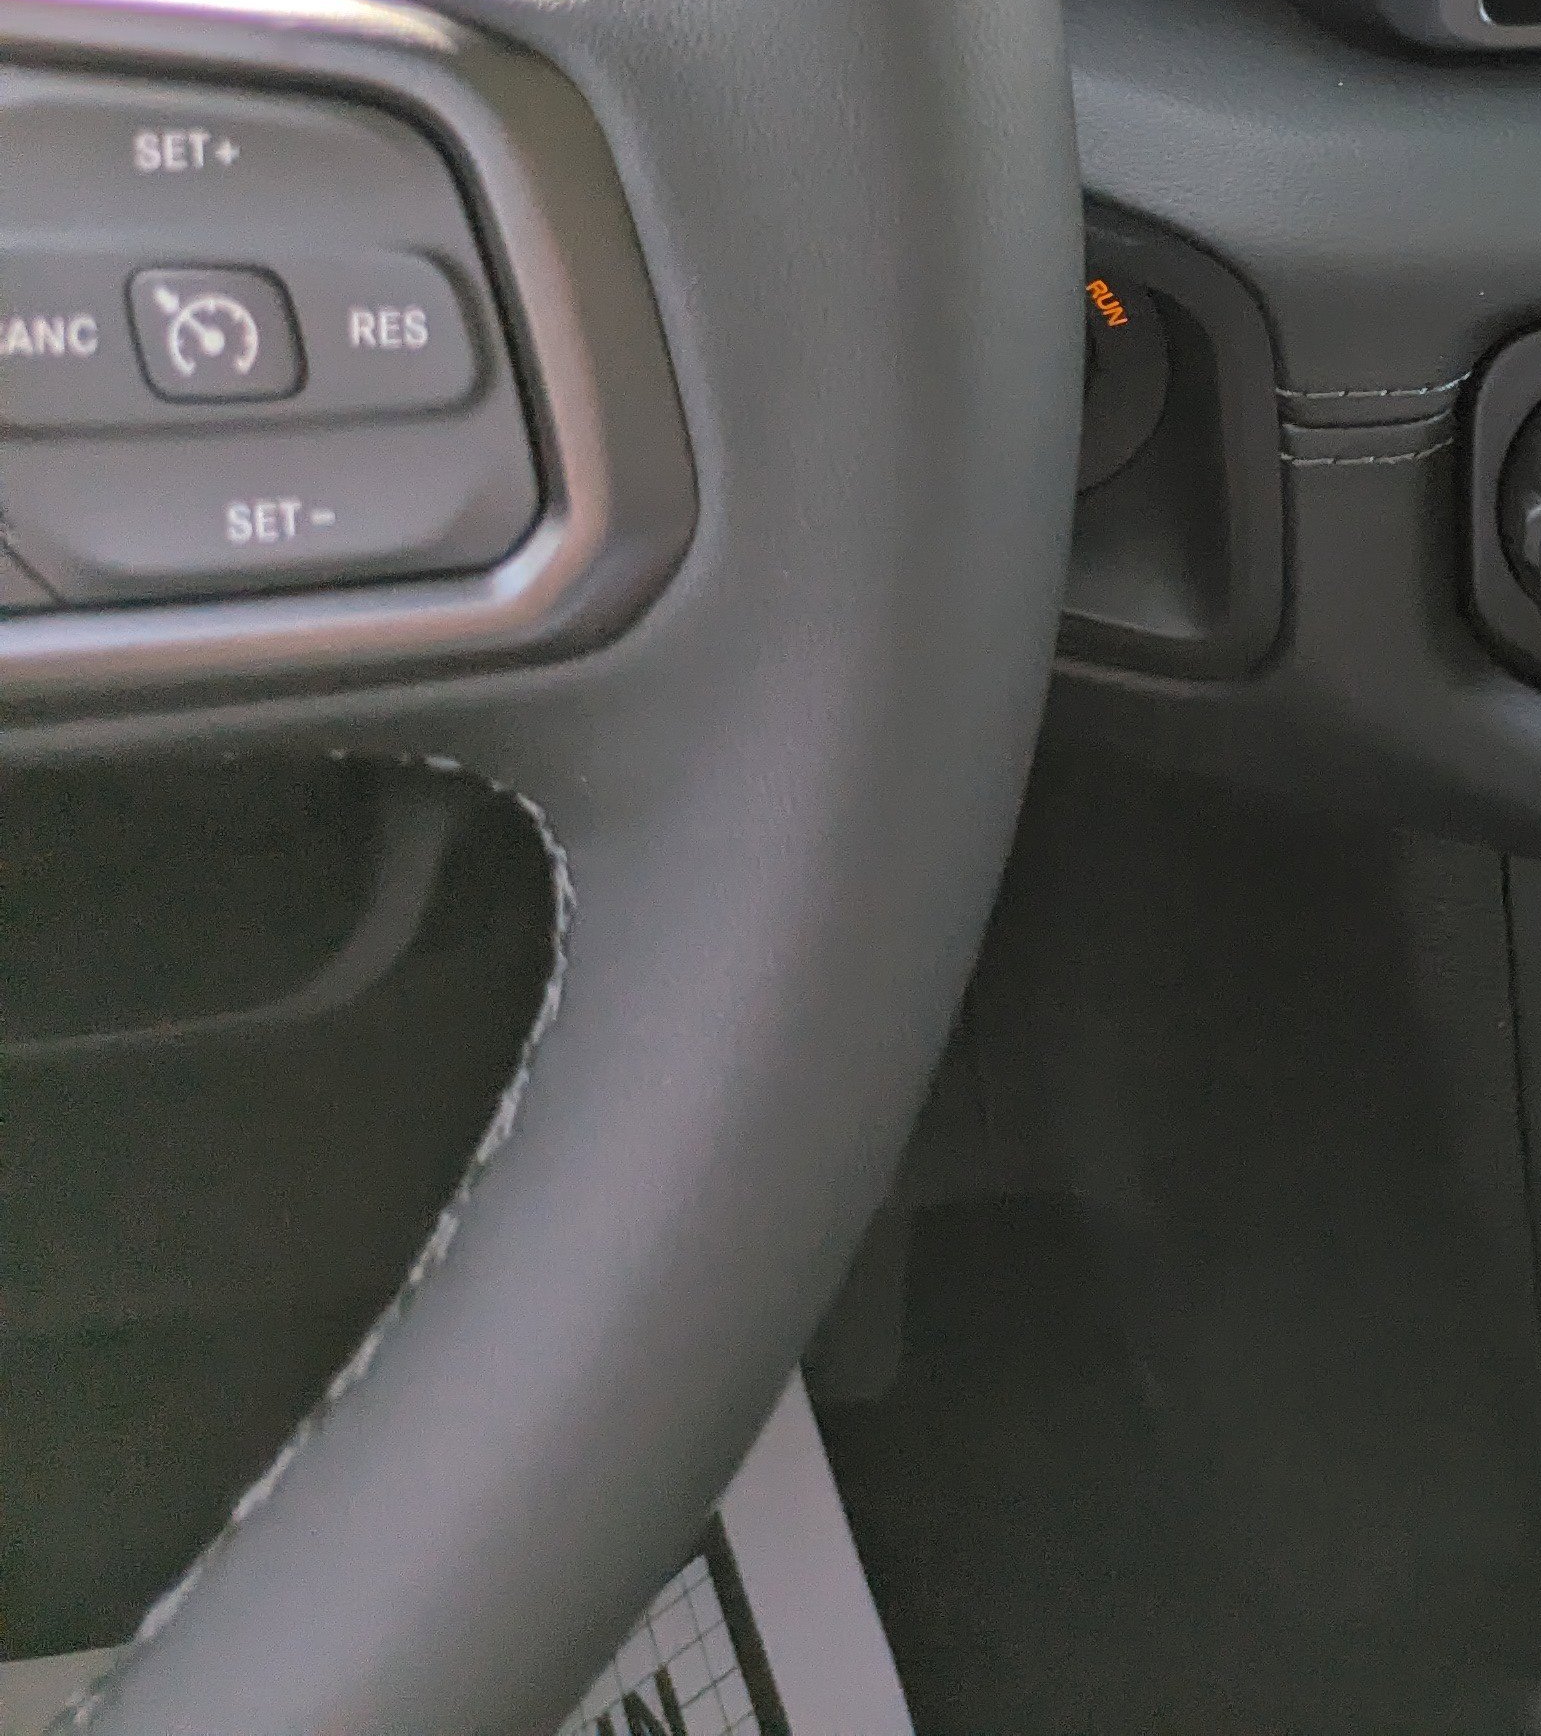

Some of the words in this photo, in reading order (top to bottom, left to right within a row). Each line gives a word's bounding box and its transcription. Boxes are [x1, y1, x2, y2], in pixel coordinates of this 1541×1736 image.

[1086, 278, 1128, 327] RUN
[0, 314, 98, 358] ANC
[349, 309, 428, 348] RES
